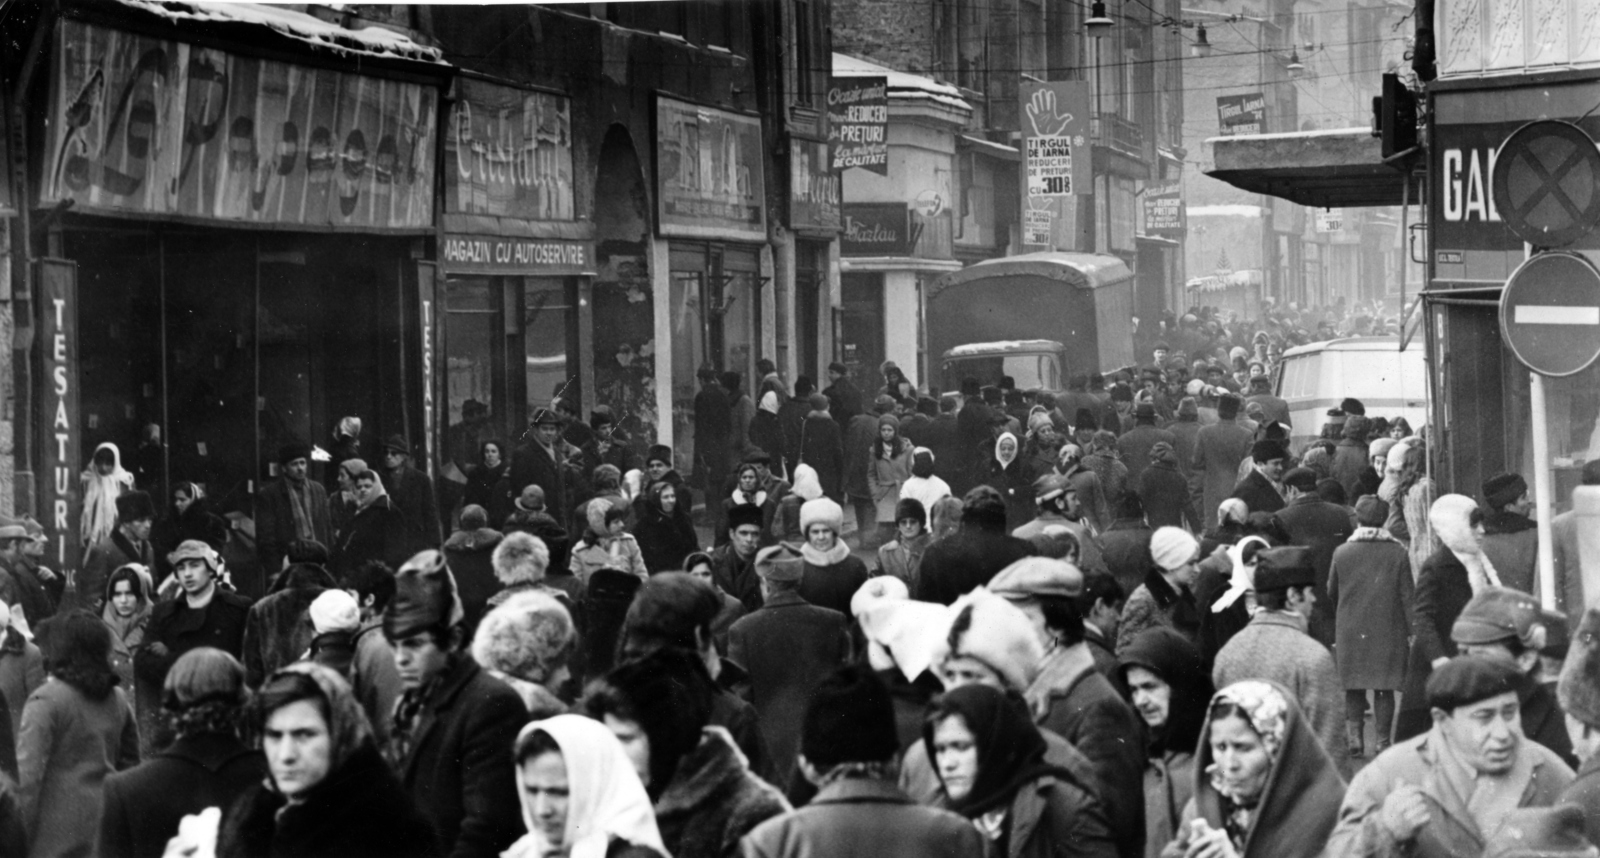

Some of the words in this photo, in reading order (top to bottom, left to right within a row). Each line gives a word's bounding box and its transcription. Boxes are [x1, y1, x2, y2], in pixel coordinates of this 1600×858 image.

[1243, 97, 1265, 113] IARNA
[848, 105, 887, 122] REDUCERI
[1028, 138, 1070, 148] TIRGUL
[1028, 149, 1039, 158] DE
[1042, 148, 1070, 157] IARNA
[833, 158, 844, 168] DE
[846, 155, 886, 166] CALITATE
[1028, 158, 1071, 167] REDUCERI
[1028, 168, 1037, 176] DE
[1443, 147, 1501, 221] GAL
[1029, 186, 1042, 195] CU
[445, 240, 491, 263] MAGAZIN
[496, 242, 511, 263] CU
[515, 243, 584, 265] AUTOSERVIRE
